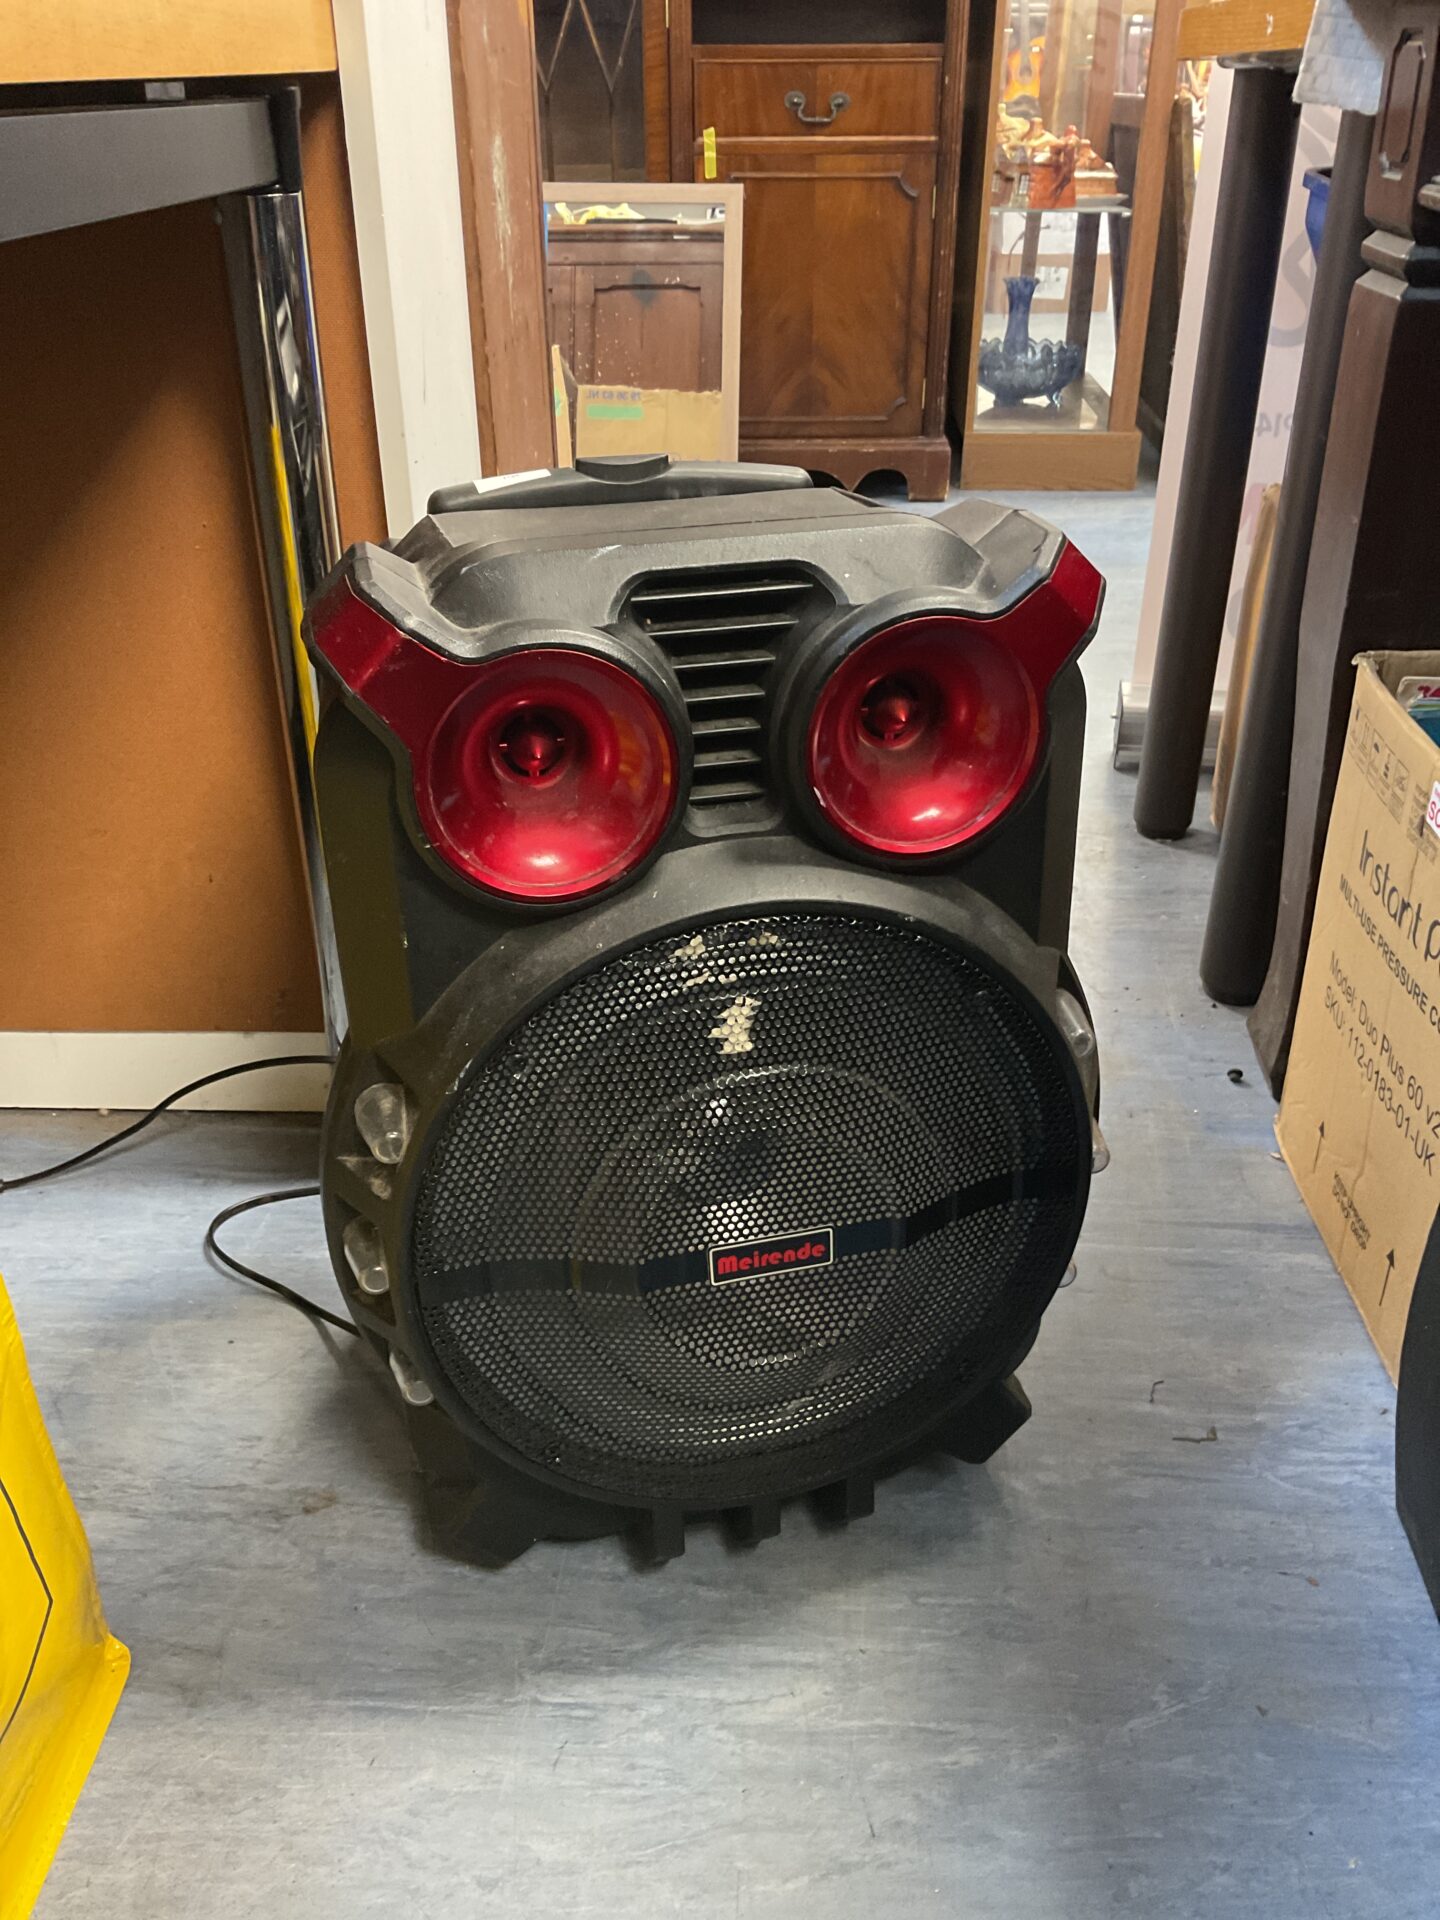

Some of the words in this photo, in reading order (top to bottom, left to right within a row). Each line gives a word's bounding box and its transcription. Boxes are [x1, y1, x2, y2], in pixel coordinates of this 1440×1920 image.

[1340, 873, 1377, 945] MULTI-USE
[1376, 934, 1428, 1015] PRESSURE
[1359, 830, 1422, 950] Instant
[1324, 985, 1346, 1037] SKU:
[1348, 1028, 1436, 1177] 112-0183-01-UK
[1330, 951, 1357, 1012] Model:
[1358, 1000, 1378, 1046] Duo
[1380, 1034, 1405, 1085] Plus
[1407, 1075, 1424, 1111] 60
[716, 1241, 826, 1275] Meirende
